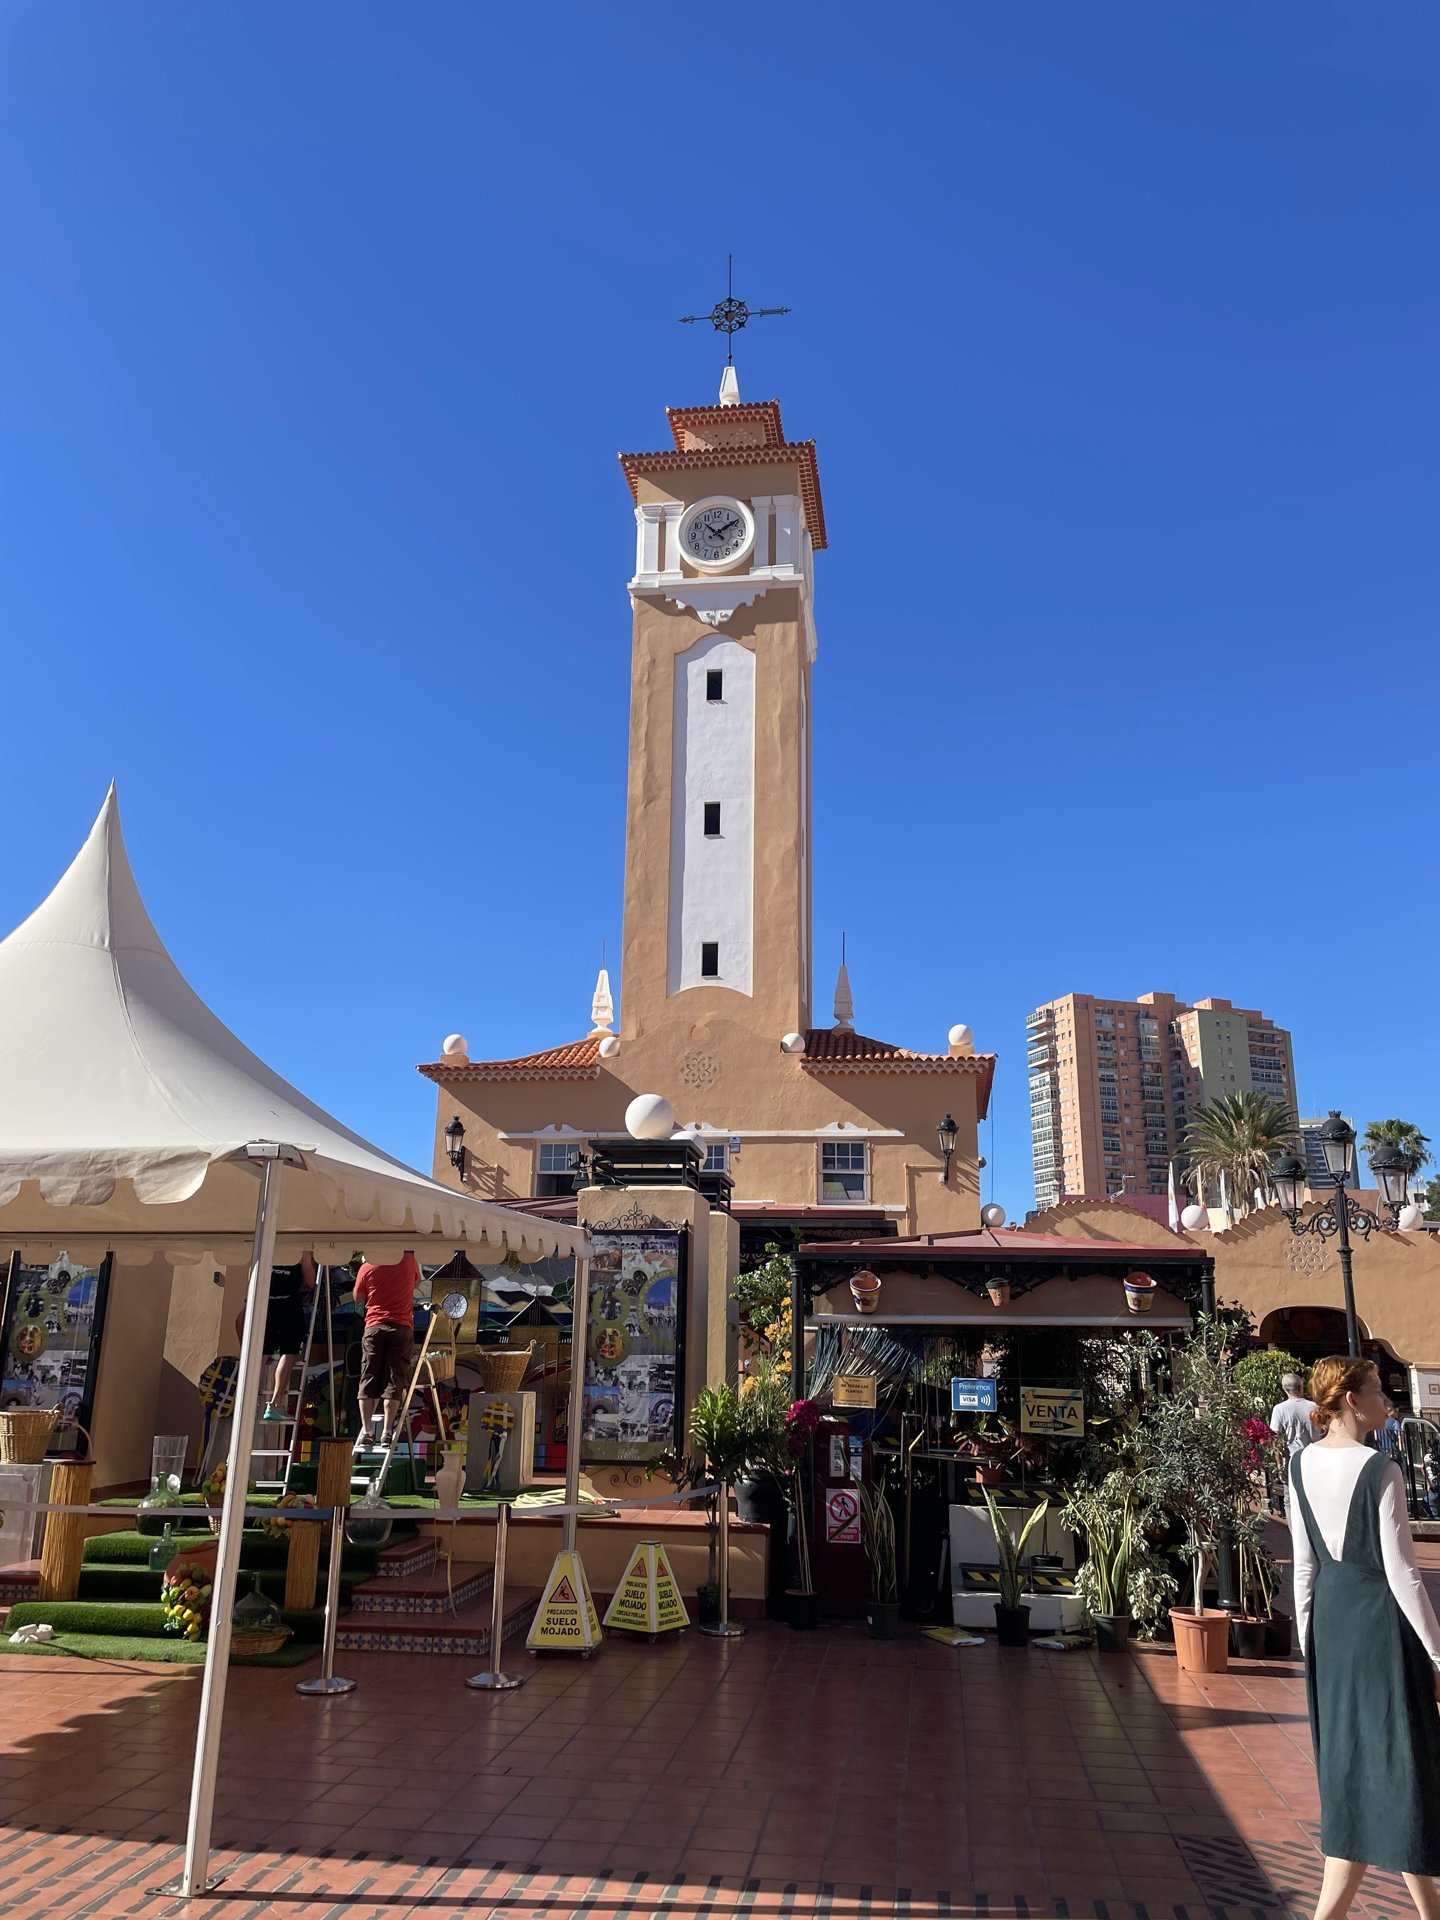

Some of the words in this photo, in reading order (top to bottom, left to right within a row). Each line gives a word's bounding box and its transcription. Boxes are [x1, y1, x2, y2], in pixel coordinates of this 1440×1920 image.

[1026, 1405, 1078, 1419] VENTA
[624, 1589, 645, 1599] SUELO
[659, 1589, 673, 1599] SUELO
[619, 1599, 646, 1610] MOJADO
[658, 1599, 677, 1610] MOJADO
[546, 1617, 577, 1626] SUELO
[541, 1627, 580, 1635] MOJADO
